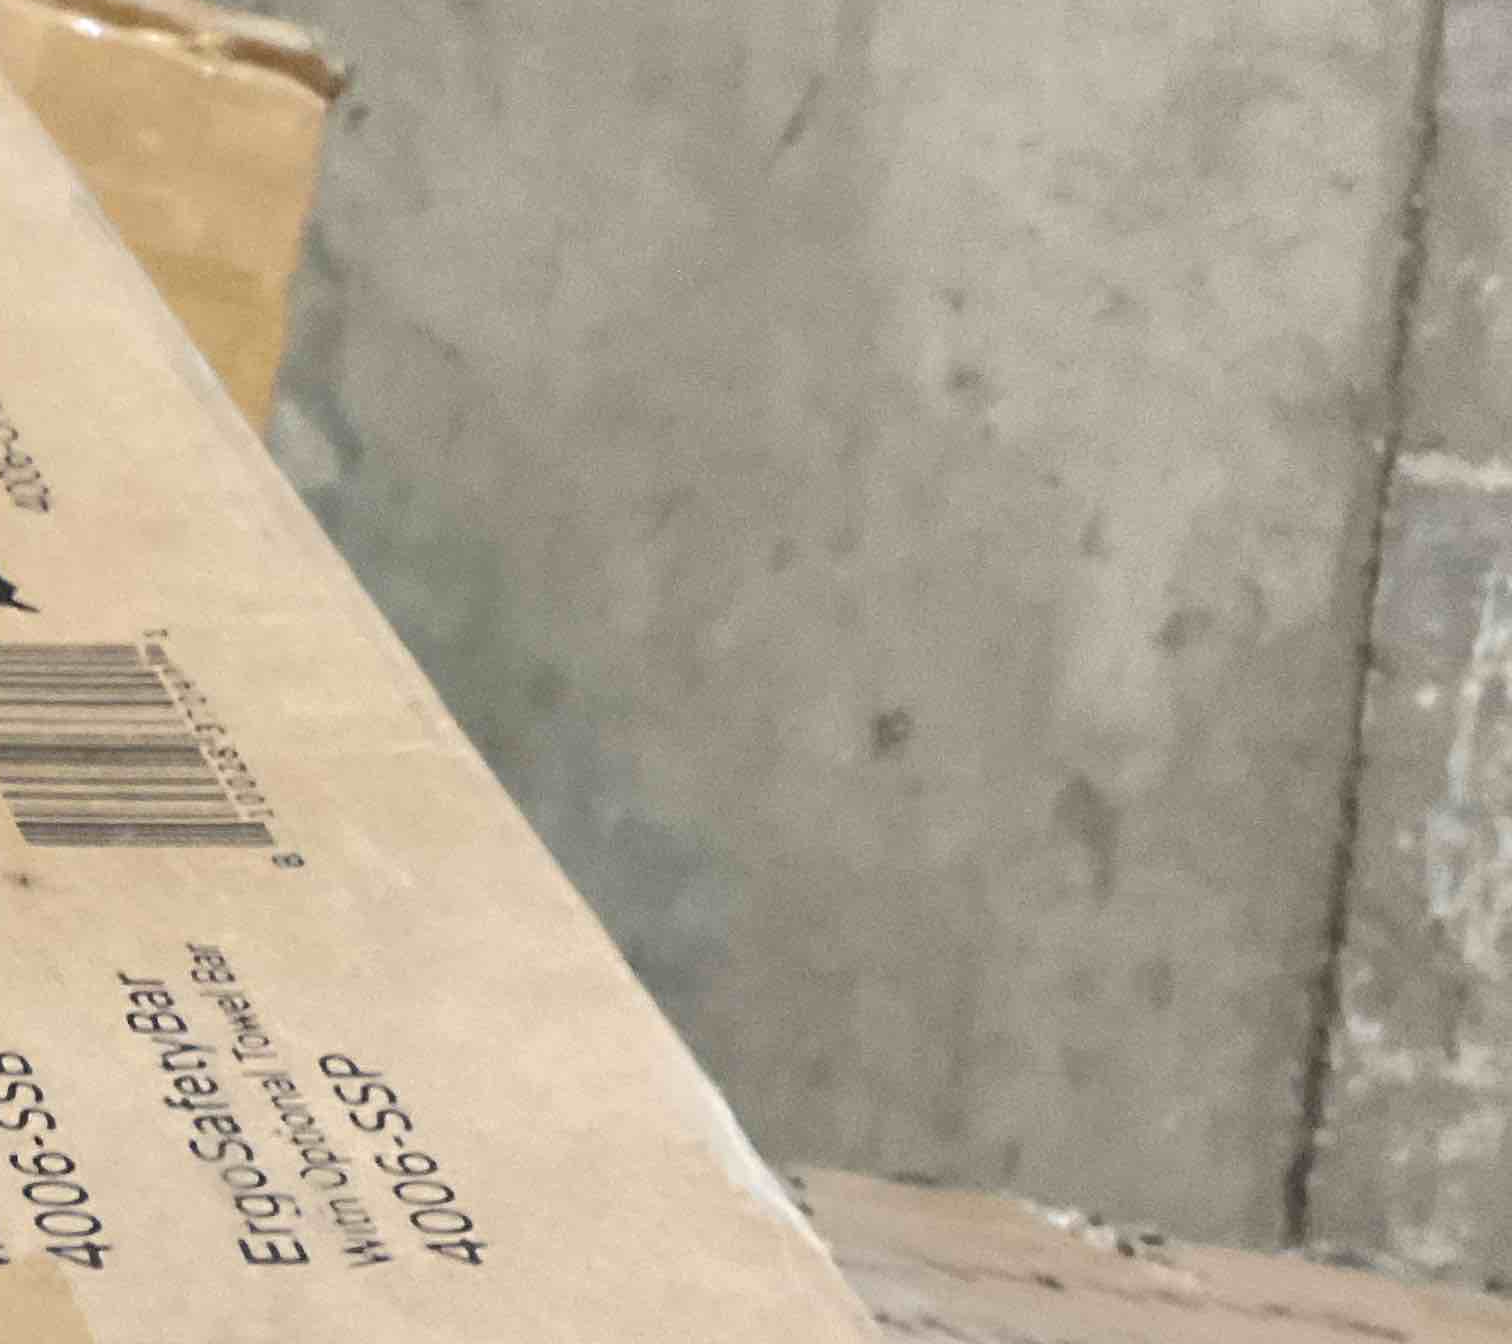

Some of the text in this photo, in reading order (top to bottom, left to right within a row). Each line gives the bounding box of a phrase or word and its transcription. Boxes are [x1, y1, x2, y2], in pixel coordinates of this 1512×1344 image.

[185, 941, 236, 984] Bar
[199, 987, 279, 1063] Towel
[117, 969, 311, 1265] ErgoSafetyBar
[240, 1069, 352, 1190] Optional
[317, 1053, 489, 1266] 4006-SSP
